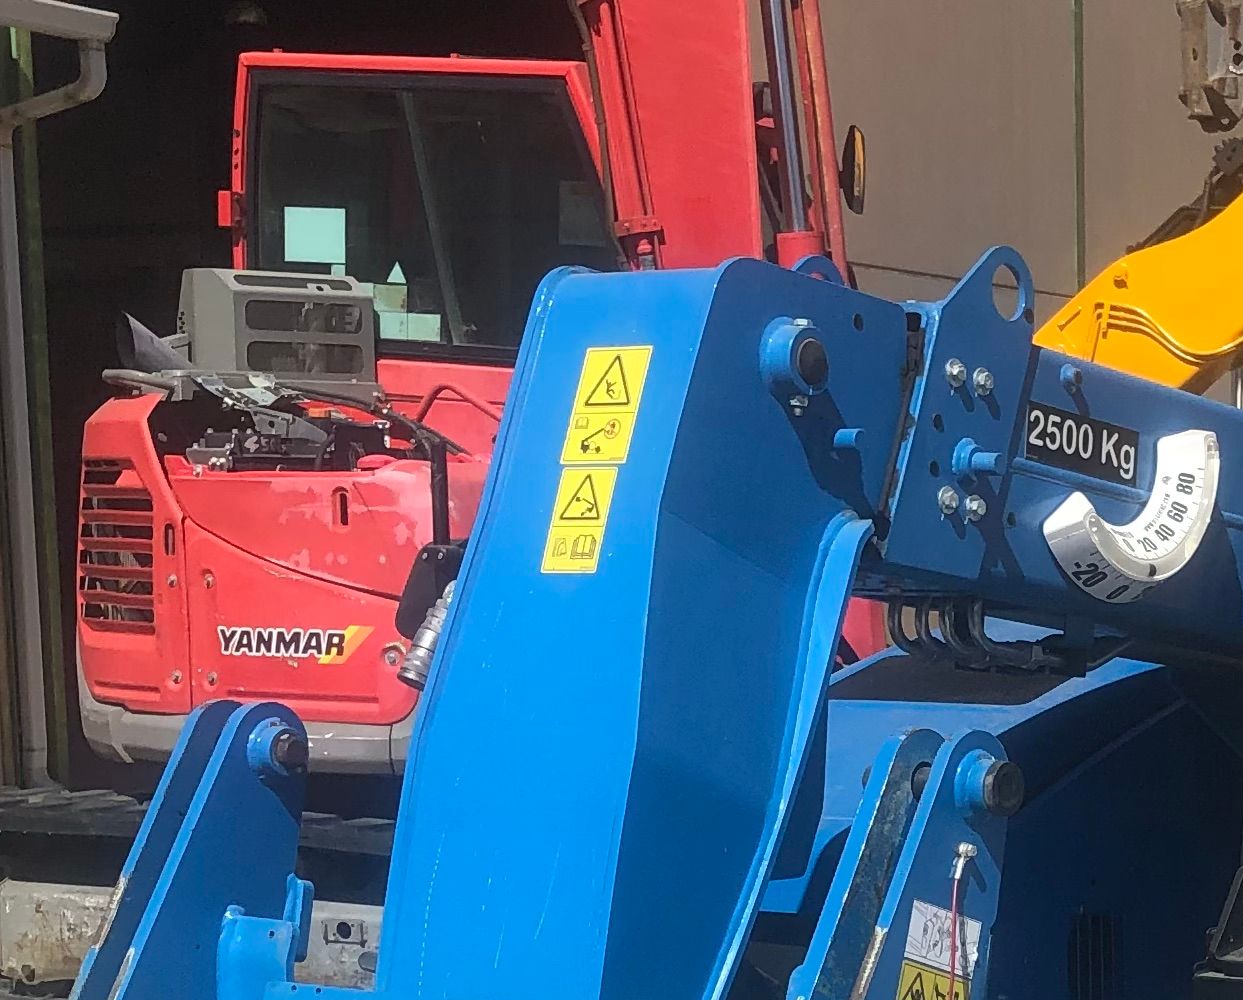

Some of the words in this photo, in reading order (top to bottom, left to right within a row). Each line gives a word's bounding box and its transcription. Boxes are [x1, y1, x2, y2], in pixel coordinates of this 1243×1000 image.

[1028, 409, 1094, 460] 2500
[1100, 429, 1135, 480] Kg
[1176, 472, 1196, 496] 80
[1167, 501, 1188, 523] 60
[1154, 523, 1175, 542] 40
[1136, 537, 1158, 553] 20
[1071, 561, 1108, 588] -20
[1105, 584, 1129, 600] 0
[218, 626, 346, 658] YANMAR
